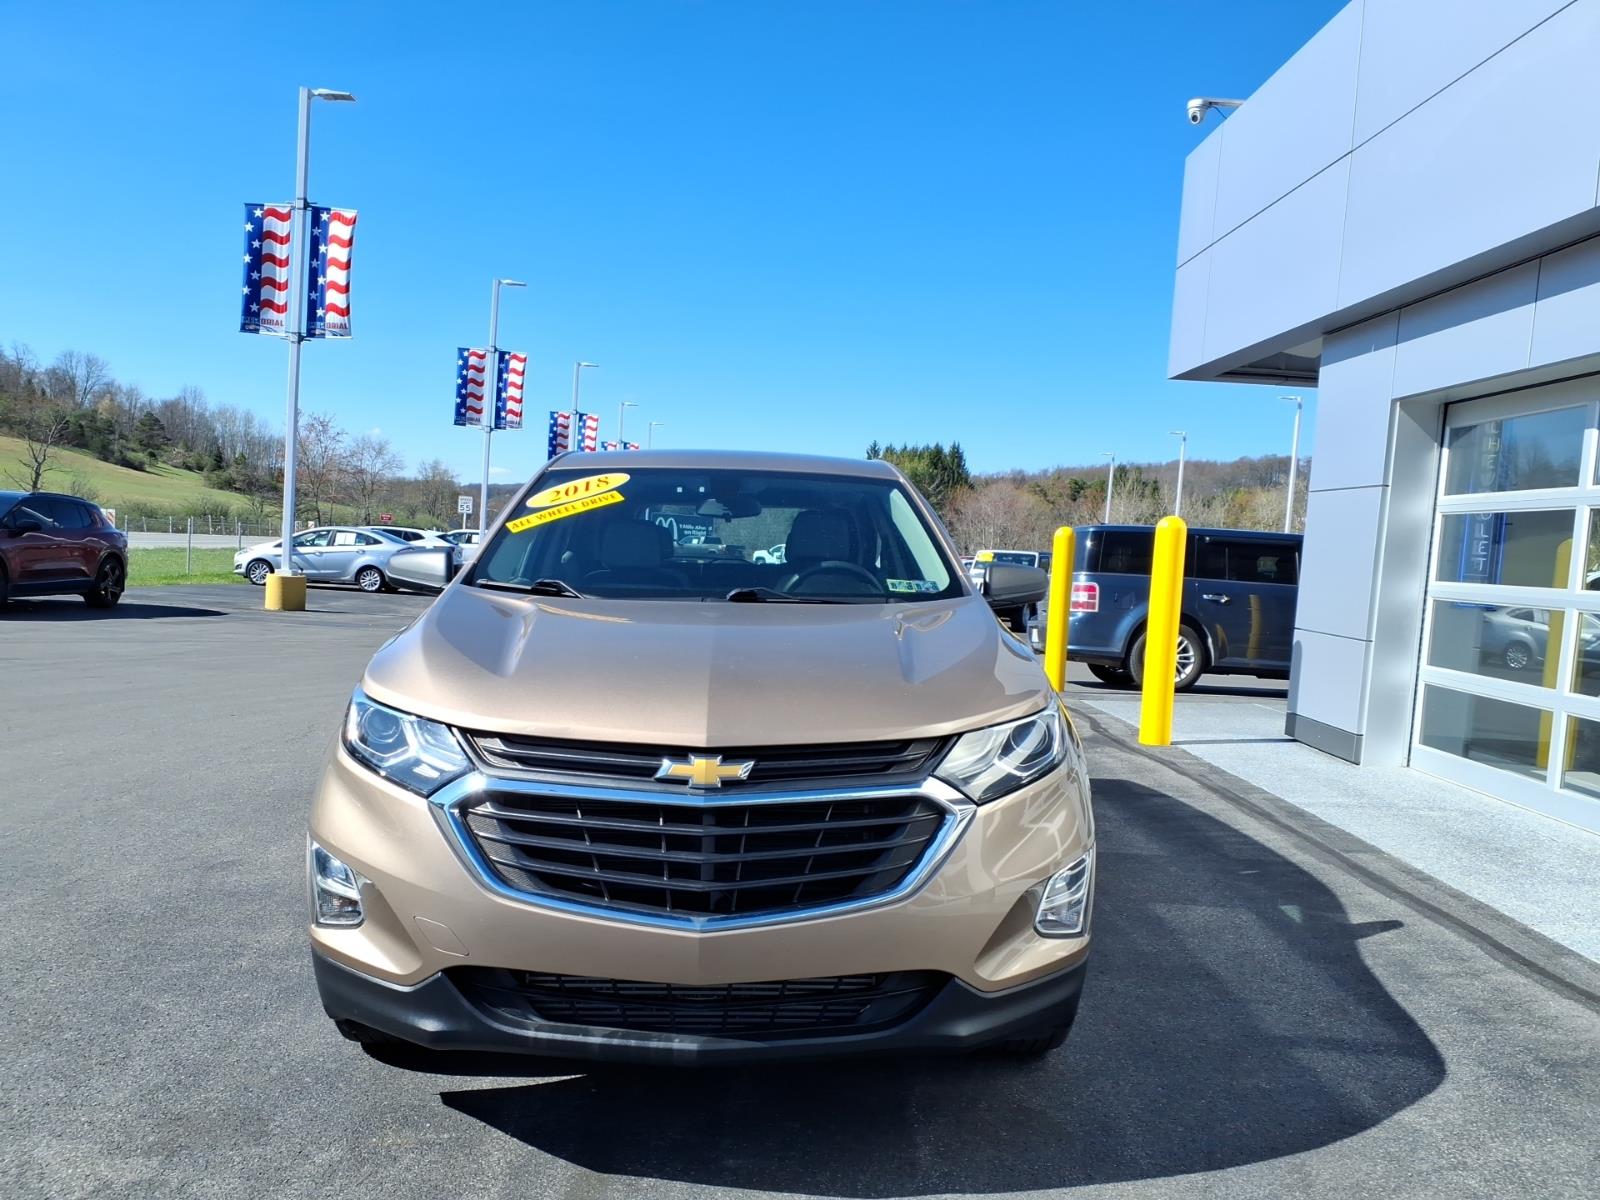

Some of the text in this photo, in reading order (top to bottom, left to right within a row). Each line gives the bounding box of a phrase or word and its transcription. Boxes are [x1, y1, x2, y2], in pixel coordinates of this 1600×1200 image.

[550, 476, 610, 503] 2018
[459, 504, 471, 512] 55
[511, 492, 616, 530] ALL WHEEL DRIVE
